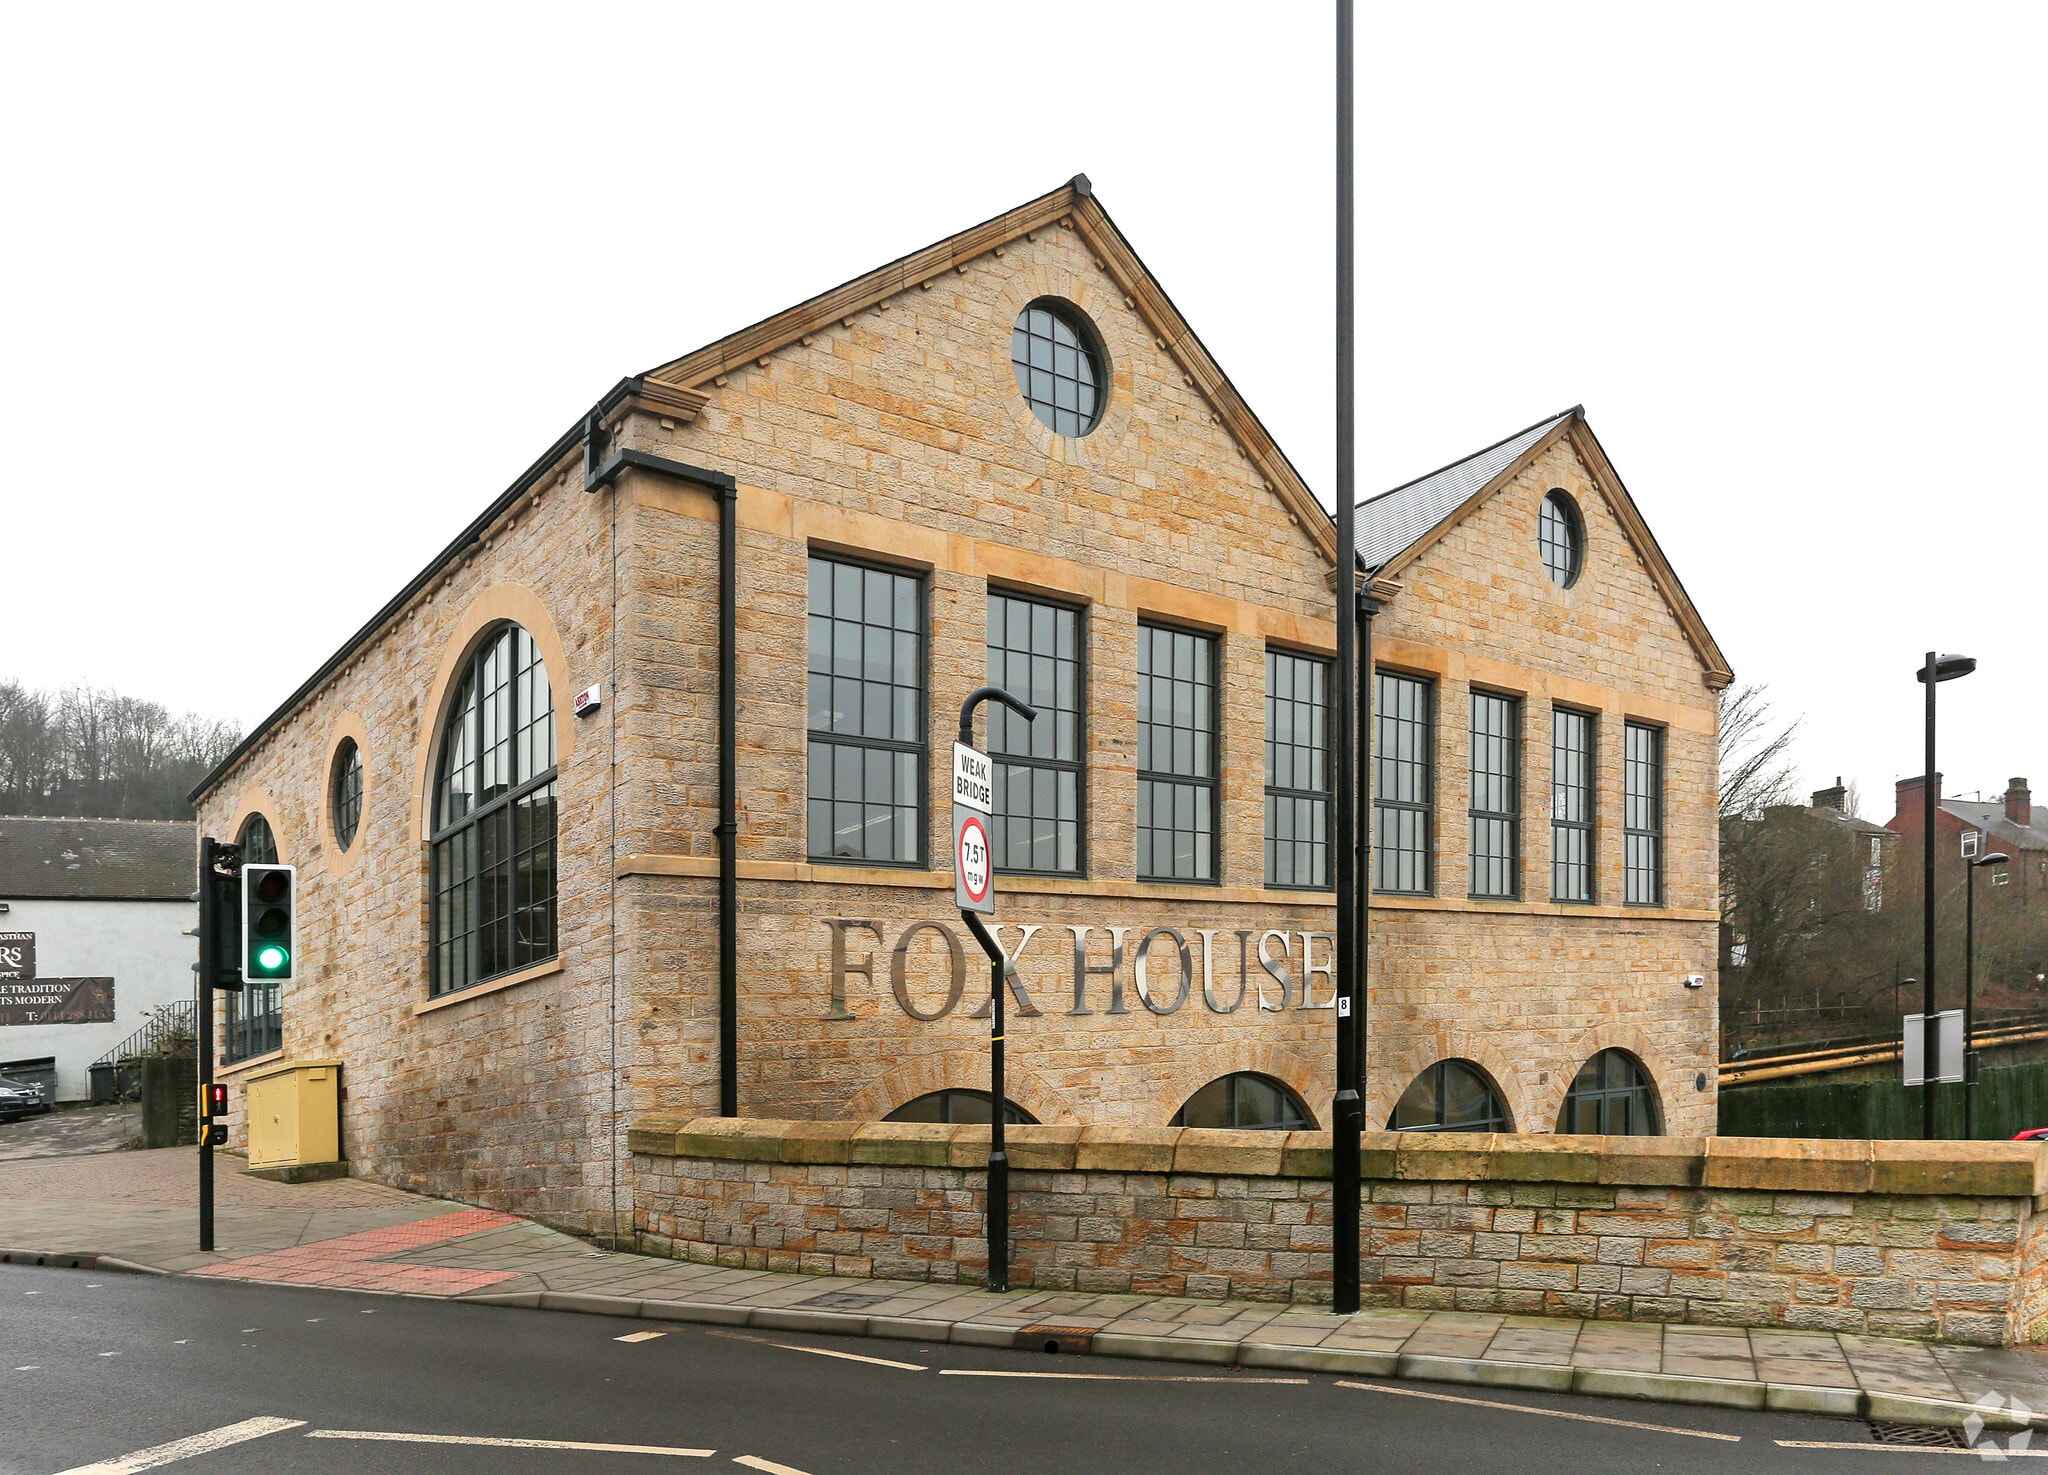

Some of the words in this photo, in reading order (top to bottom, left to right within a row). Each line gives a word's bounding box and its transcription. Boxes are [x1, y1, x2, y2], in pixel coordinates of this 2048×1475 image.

[961, 754, 987, 781] WEAK
[957, 776, 990, 805] BRIDGE
[820, 918, 1043, 1021] FOX
[1066, 926, 1337, 1015] HOUSE
[9, 984, 71, 994] TRADITION
[15, 995, 62, 1005] MODERN
[1341, 999, 1347, 1010] 8
[25, 1011, 38, 1021] T:
